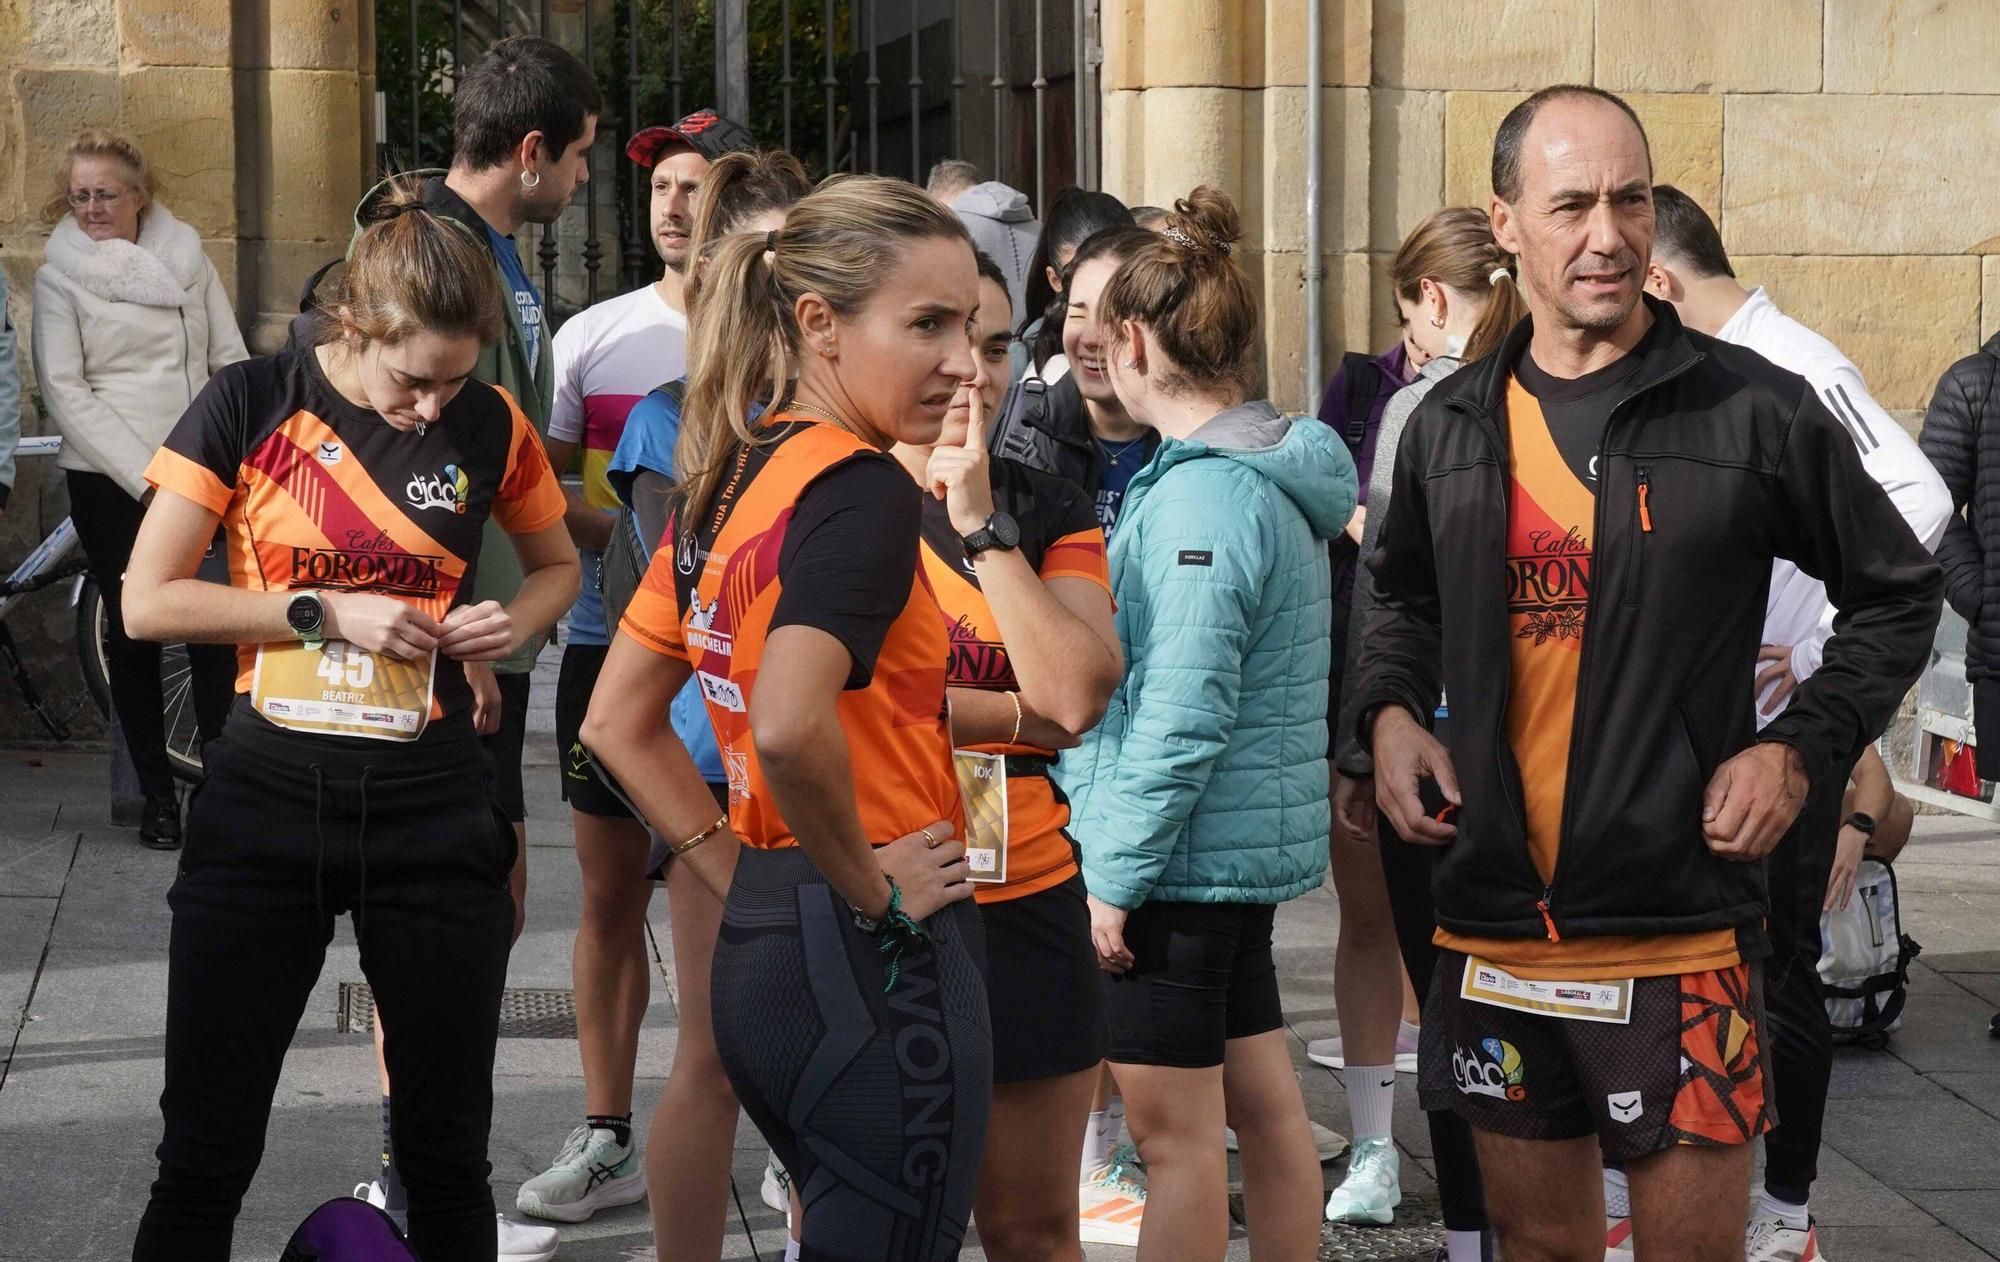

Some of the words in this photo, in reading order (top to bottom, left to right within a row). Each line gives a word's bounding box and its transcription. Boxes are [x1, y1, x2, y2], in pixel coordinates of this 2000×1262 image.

[1528, 525, 1587, 557] Cafés
[291, 547, 441, 591] FORONDA
[316, 641, 375, 689] 45
[322, 689, 366, 705] BEATRIZ
[973, 764, 993, 780] 10K
